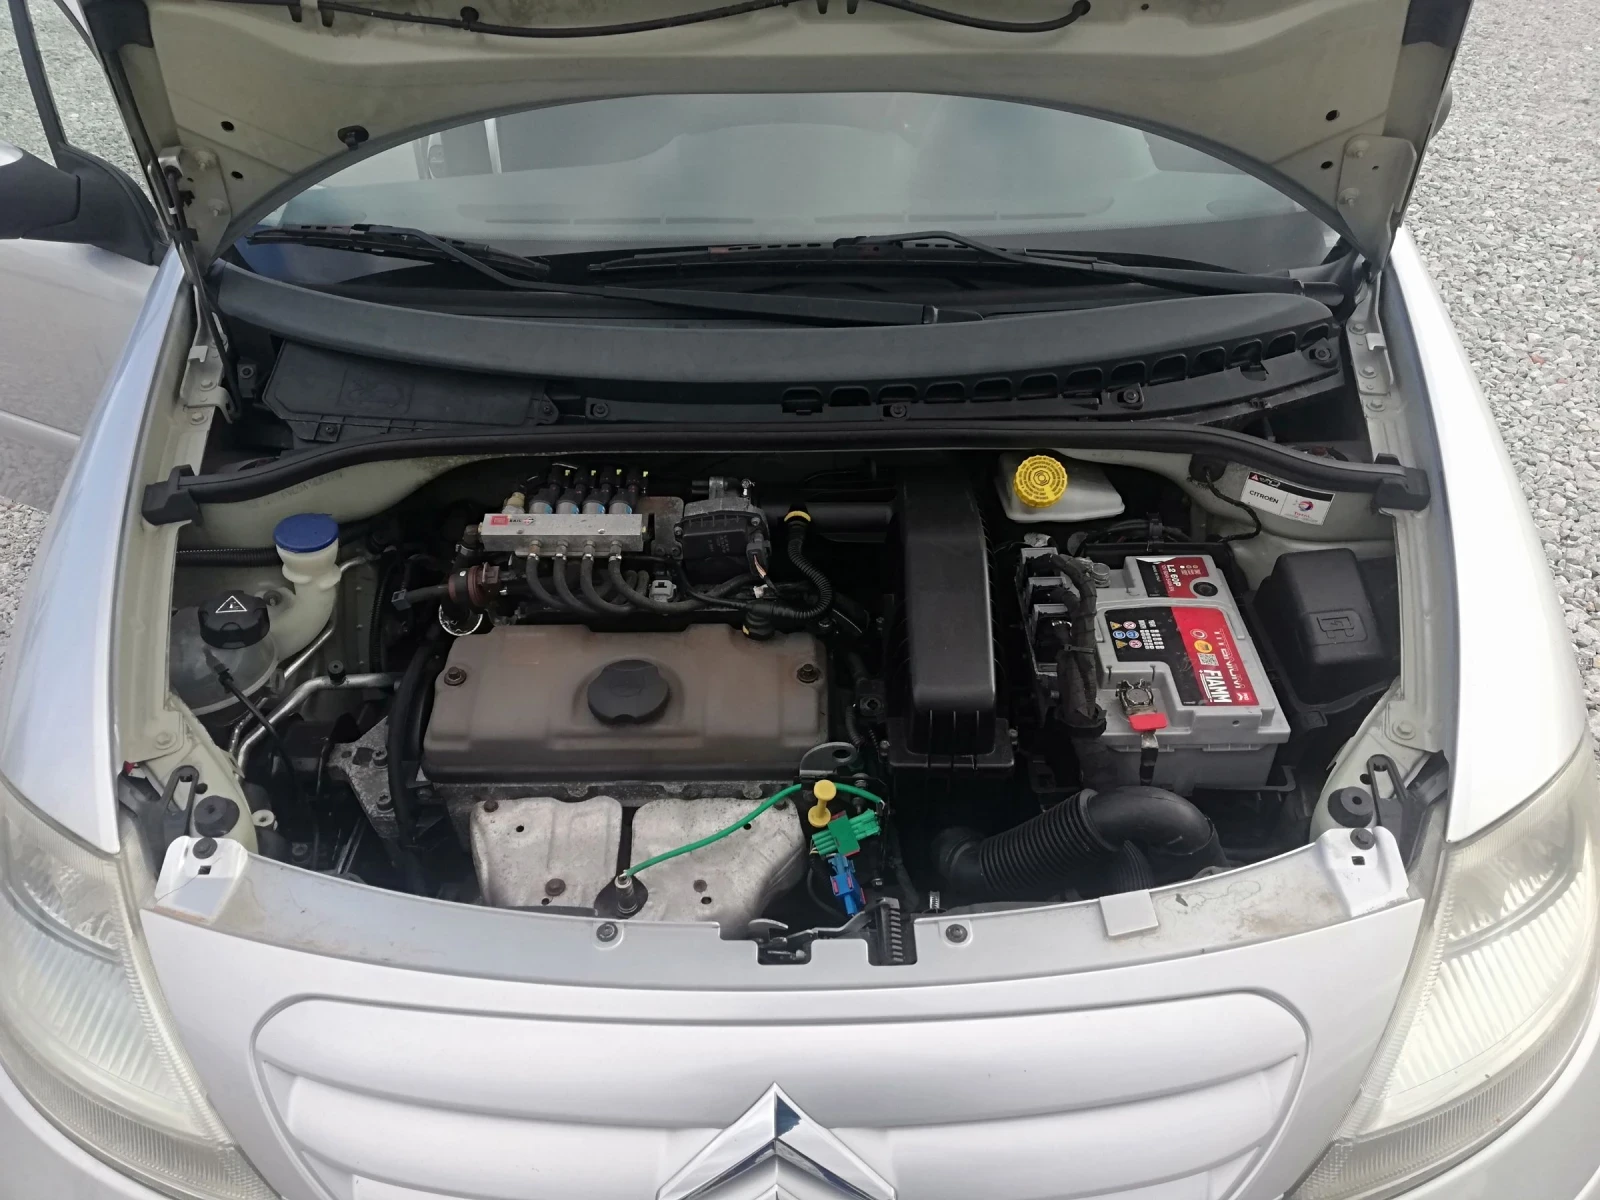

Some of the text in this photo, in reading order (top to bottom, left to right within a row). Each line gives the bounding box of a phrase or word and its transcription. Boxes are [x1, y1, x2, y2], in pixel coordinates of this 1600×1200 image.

[1166, 564, 1177, 573] L2
[1214, 628, 1246, 689] TITANIUM
[1203, 669, 1233, 703] FIAMM
